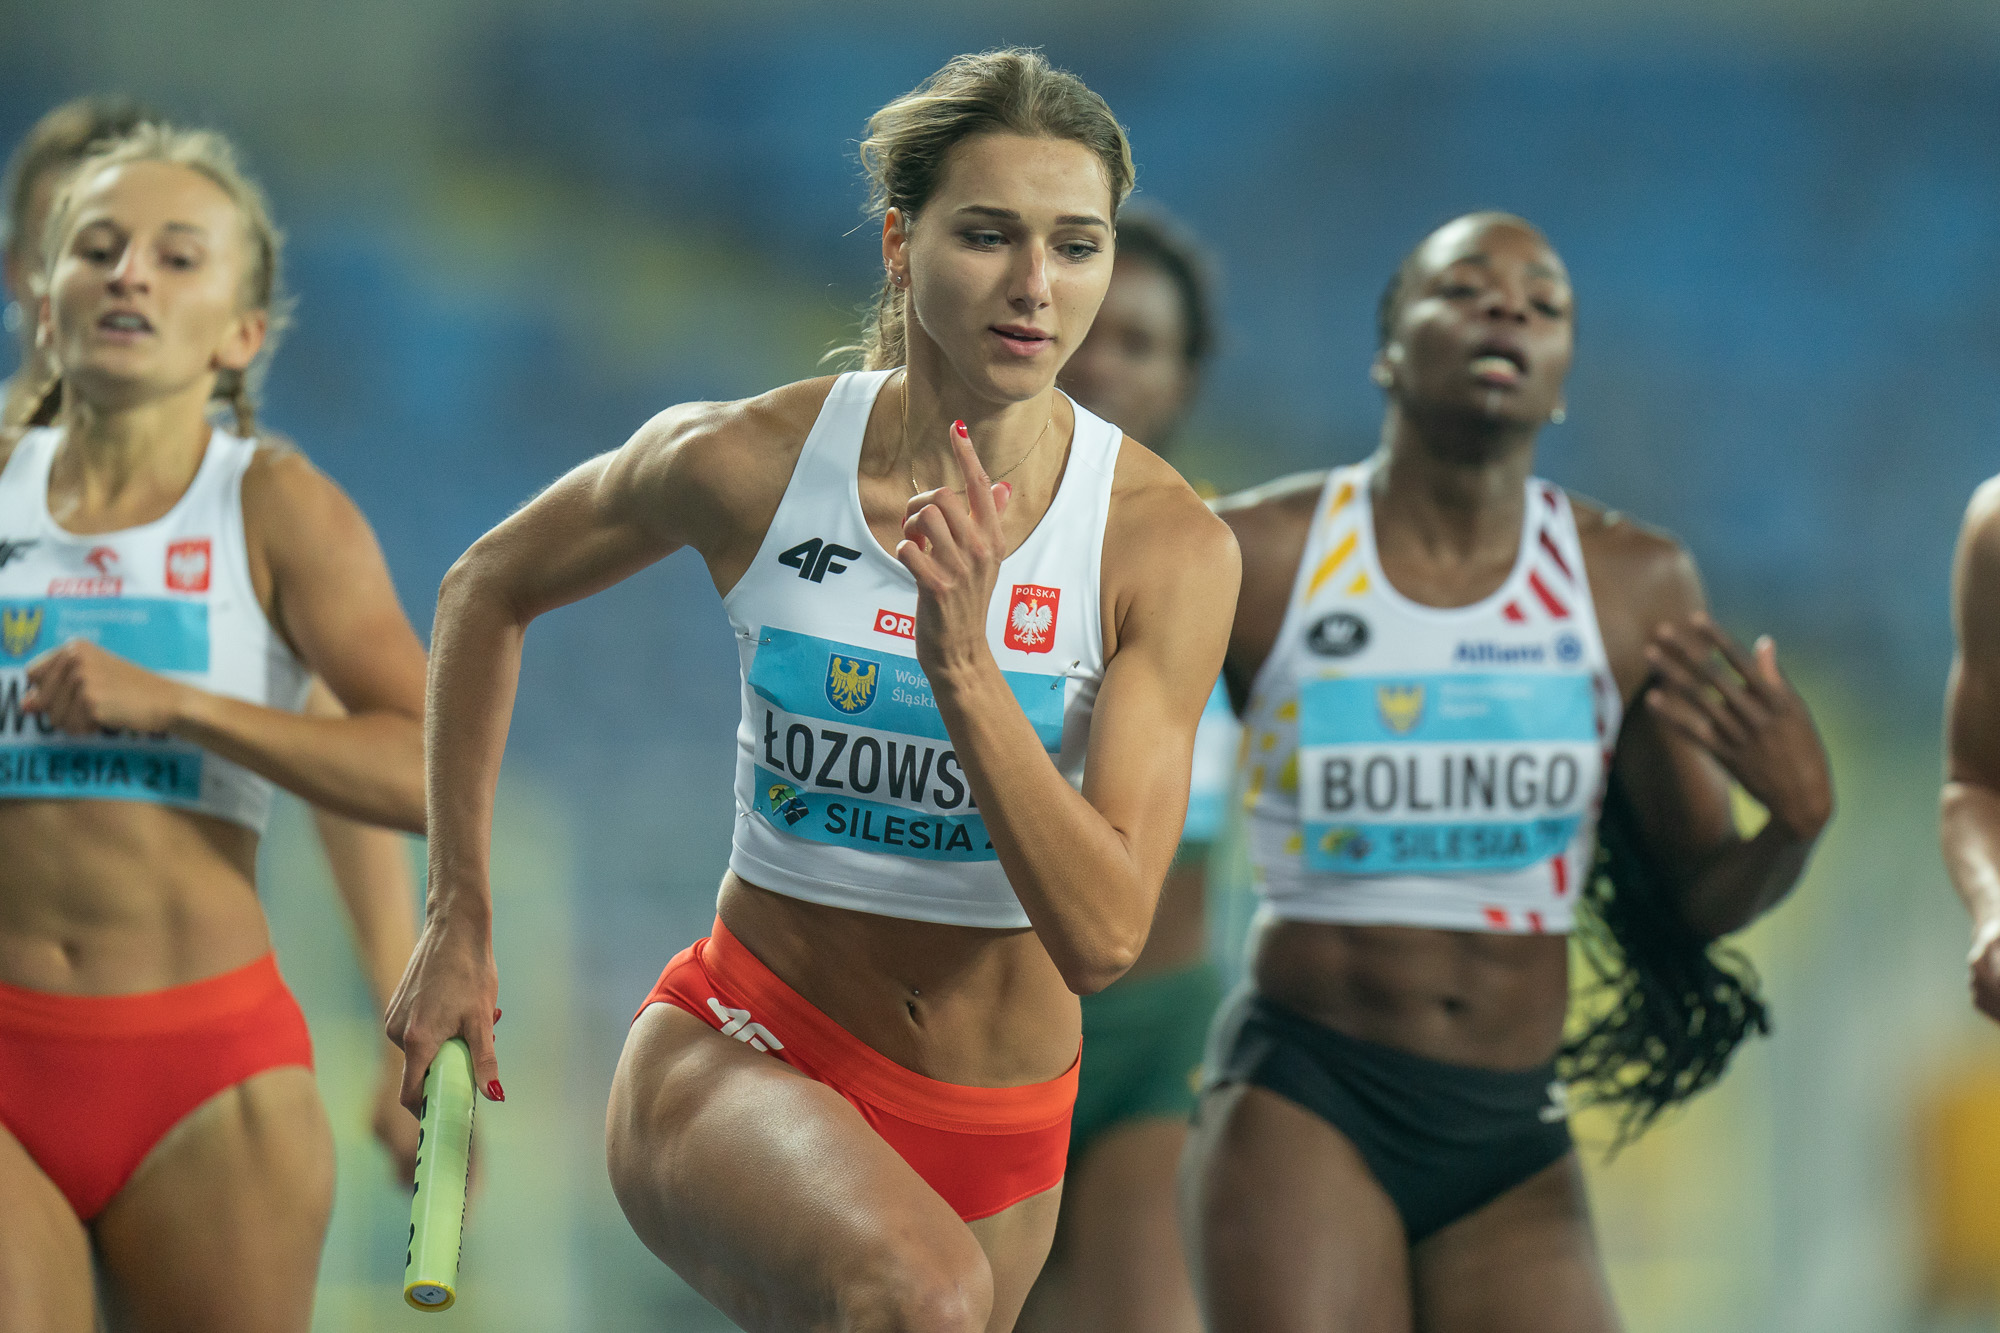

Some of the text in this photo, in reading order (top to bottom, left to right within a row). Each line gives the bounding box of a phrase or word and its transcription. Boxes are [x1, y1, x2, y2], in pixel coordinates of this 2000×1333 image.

[778, 537, 862, 583] 4F
[1015, 587, 1057, 599] POLSKA
[880, 614, 916, 637] OR
[764, 709, 979, 810] ŁOZOWS
[1321, 753, 1580, 813] BOLINGO
[825, 803, 974, 852] SILESIA
